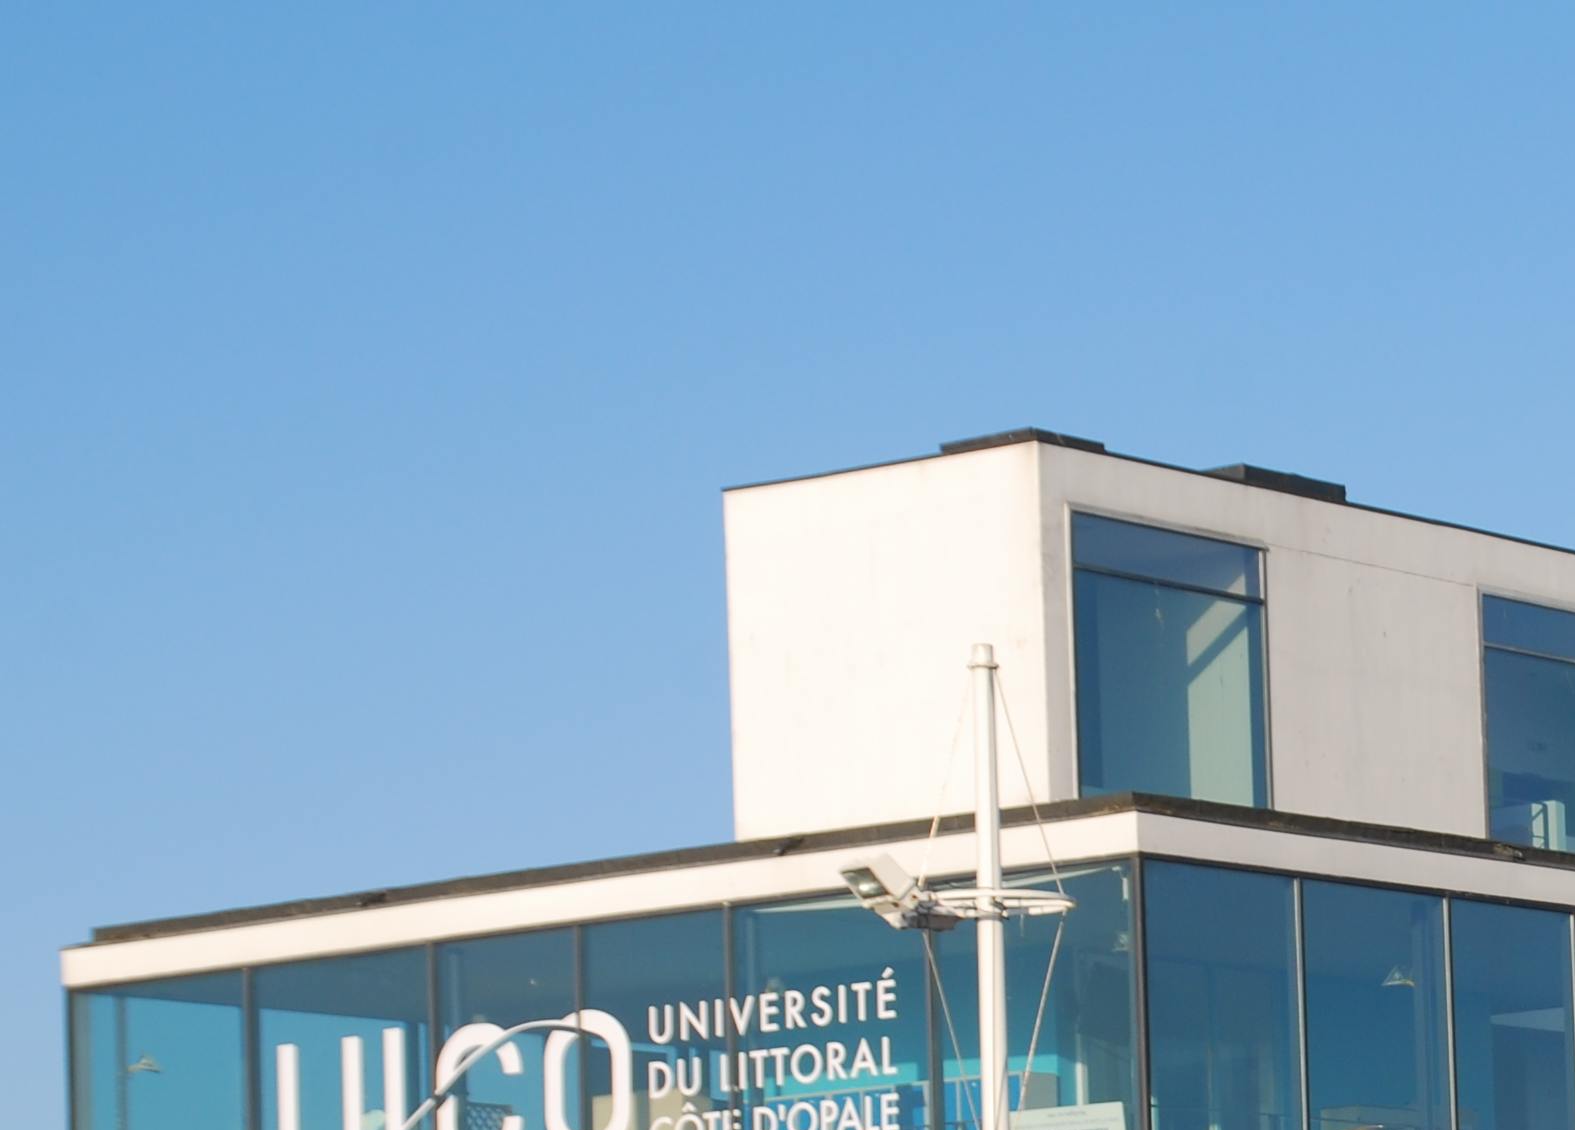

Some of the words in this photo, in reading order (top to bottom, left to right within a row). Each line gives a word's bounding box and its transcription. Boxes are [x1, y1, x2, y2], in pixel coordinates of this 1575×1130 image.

[648, 966, 898, 1044] UNIVERSITÉ
[648, 1056, 702, 1099] DU
[719, 1036, 898, 1092] LITTORAL
